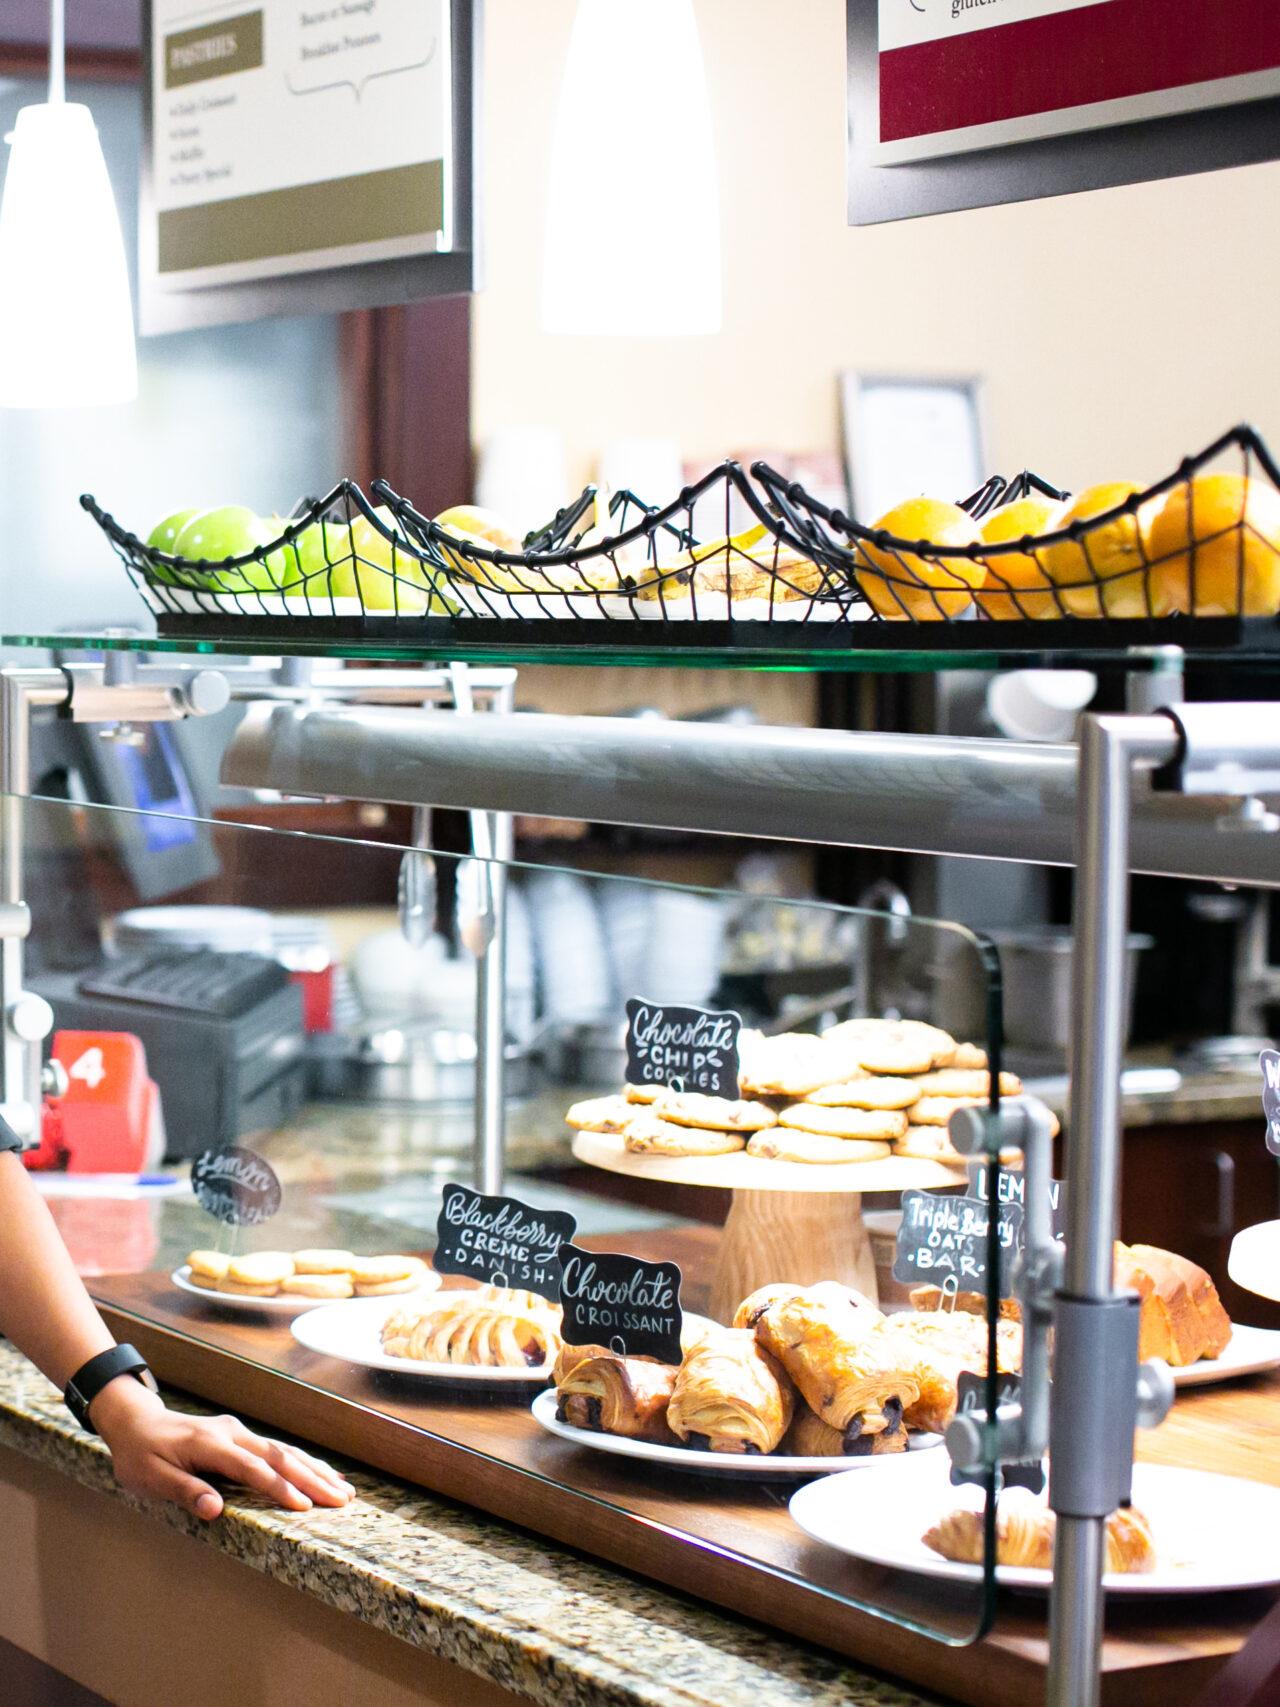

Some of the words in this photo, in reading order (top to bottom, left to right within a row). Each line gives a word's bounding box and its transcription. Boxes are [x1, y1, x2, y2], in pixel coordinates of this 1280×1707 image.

[633, 1006, 733, 1050] Chocolate
[70, 1047, 106, 1088] 4
[445, 1191, 563, 1263] Blackberry
[909, 1197, 959, 1237] Triple
[455, 1248, 546, 1284] DANISH
[460, 1229, 530, 1263] CREME
[916, 1248, 980, 1278] BAR
[561, 1257, 674, 1310] Chocolate
[575, 1304, 675, 1335] CROISSANT
